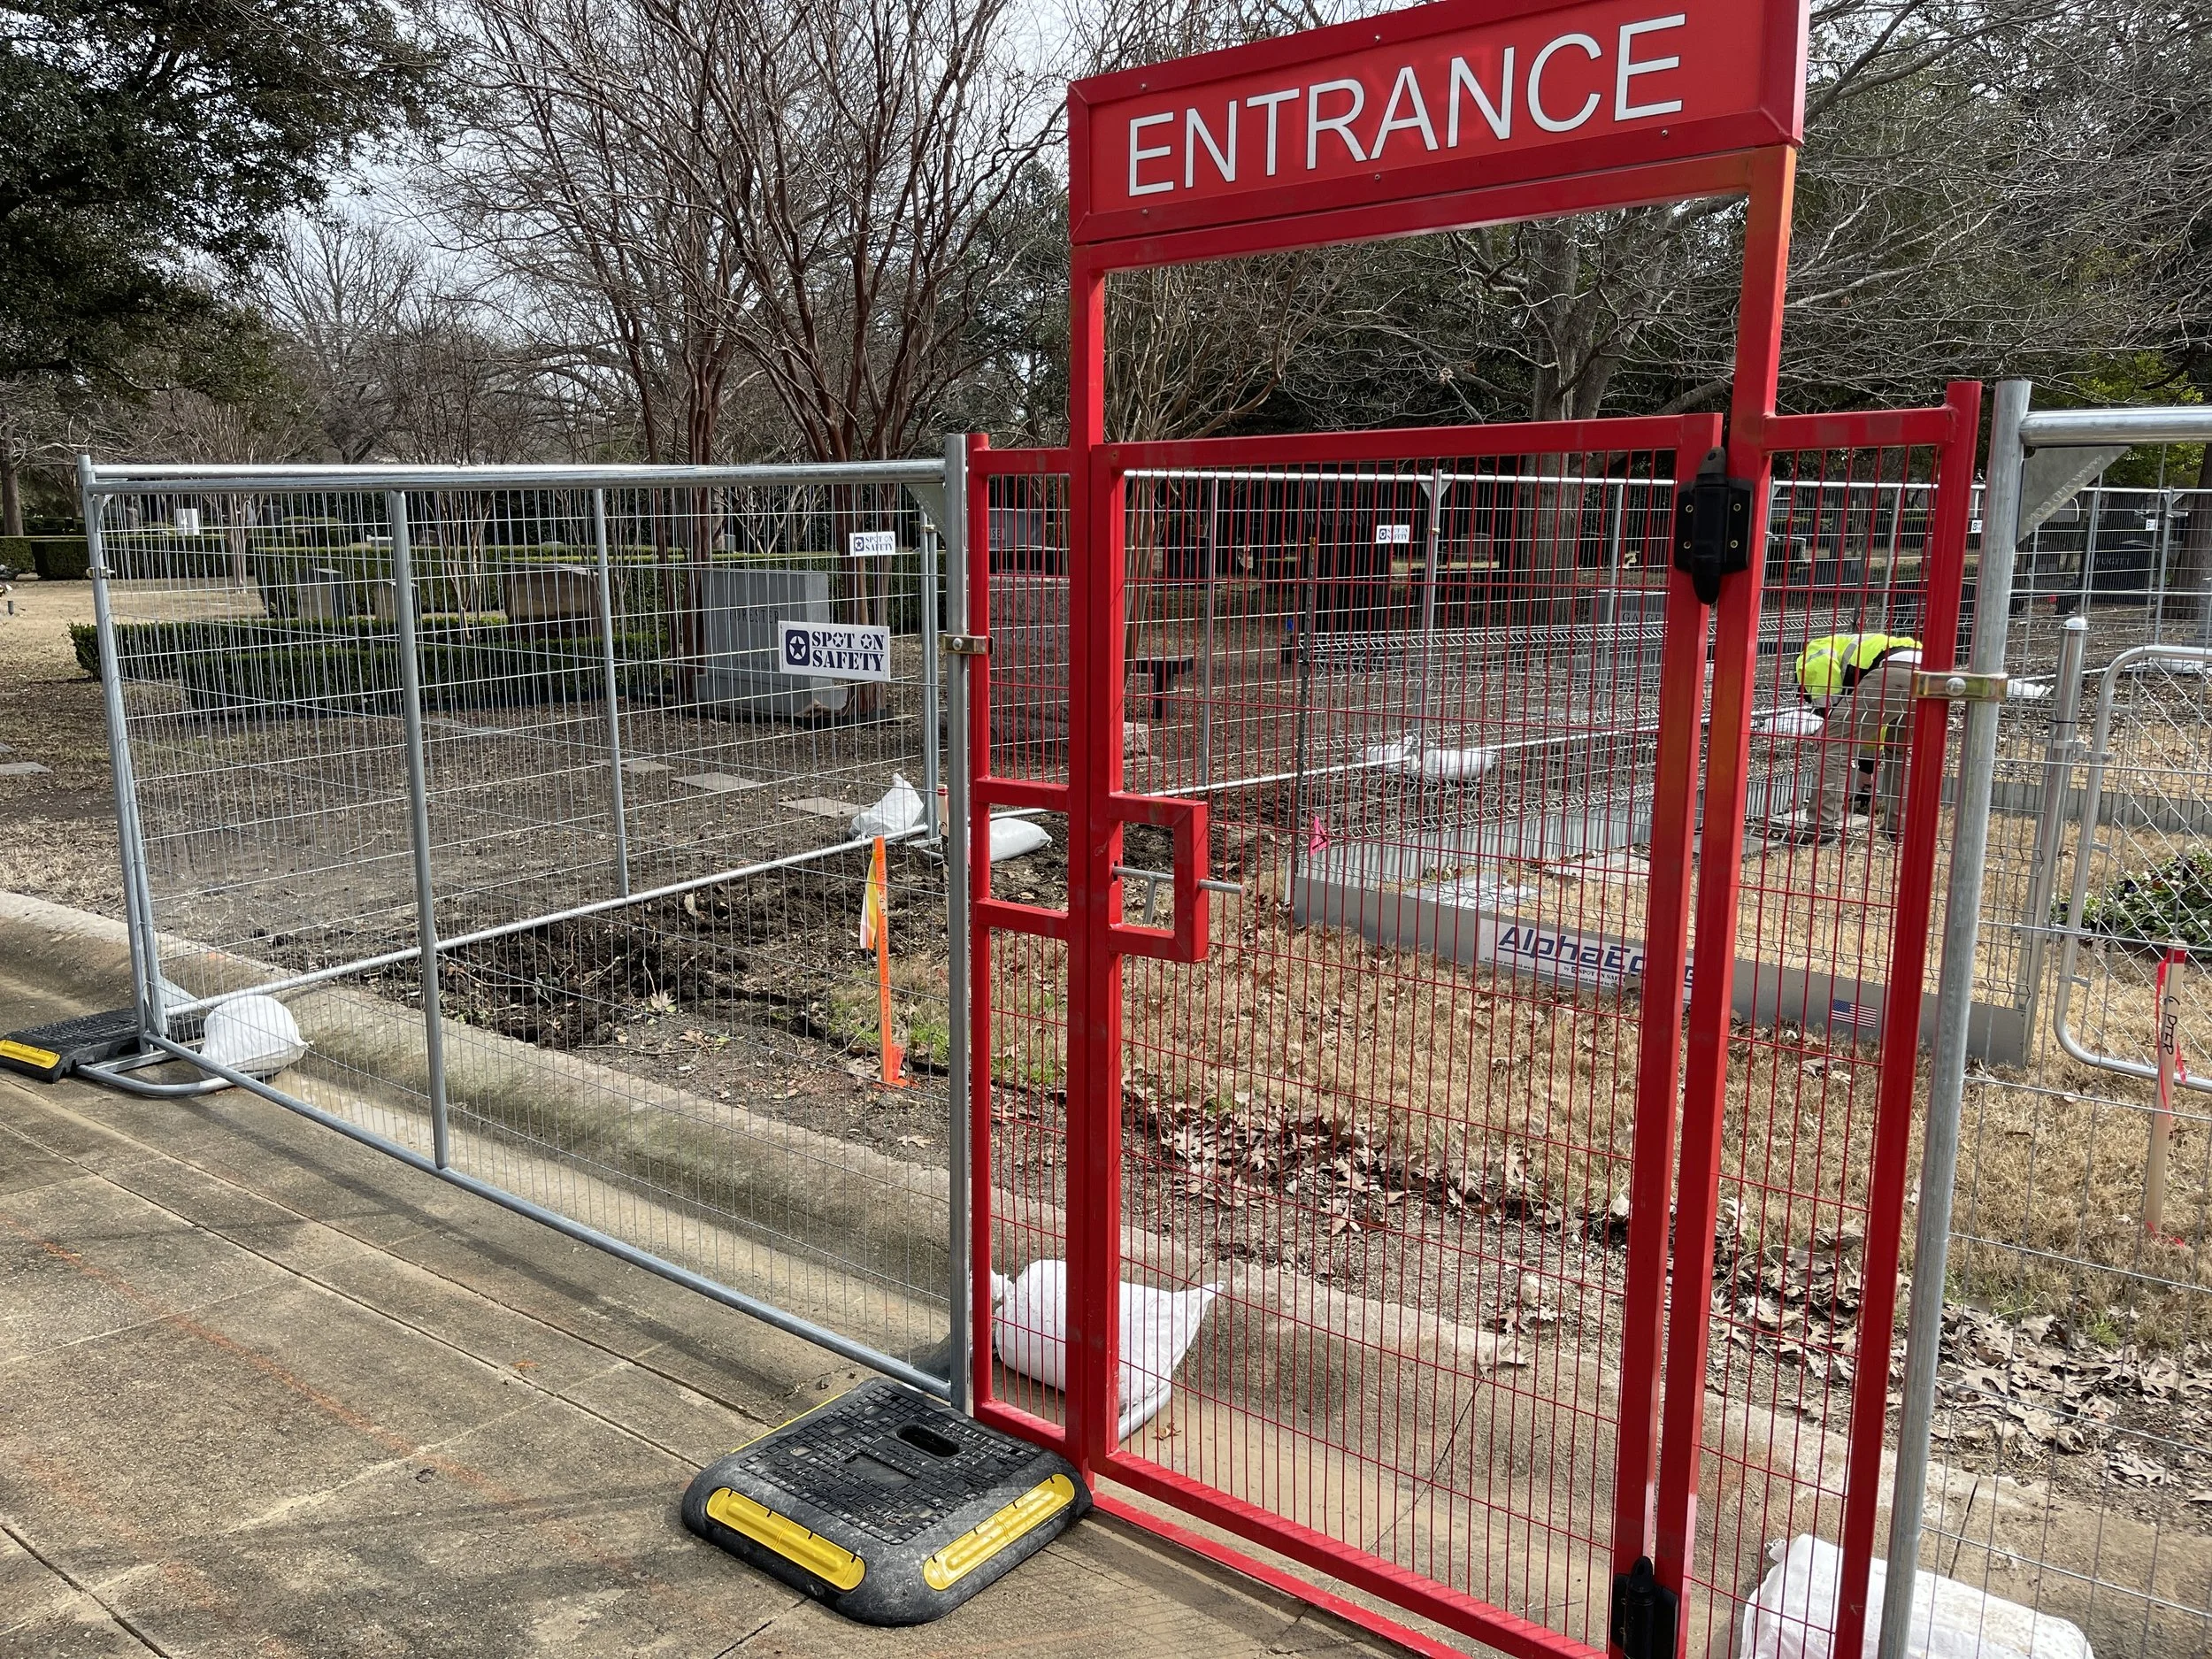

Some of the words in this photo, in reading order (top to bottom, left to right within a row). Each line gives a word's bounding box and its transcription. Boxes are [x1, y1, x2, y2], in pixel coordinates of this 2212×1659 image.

[1126, 12, 1687, 197] ENTRANCE
[811, 631, 855, 649] SPOT
[860, 634, 885, 651] ON
[812, 650, 885, 672] SAFETY
